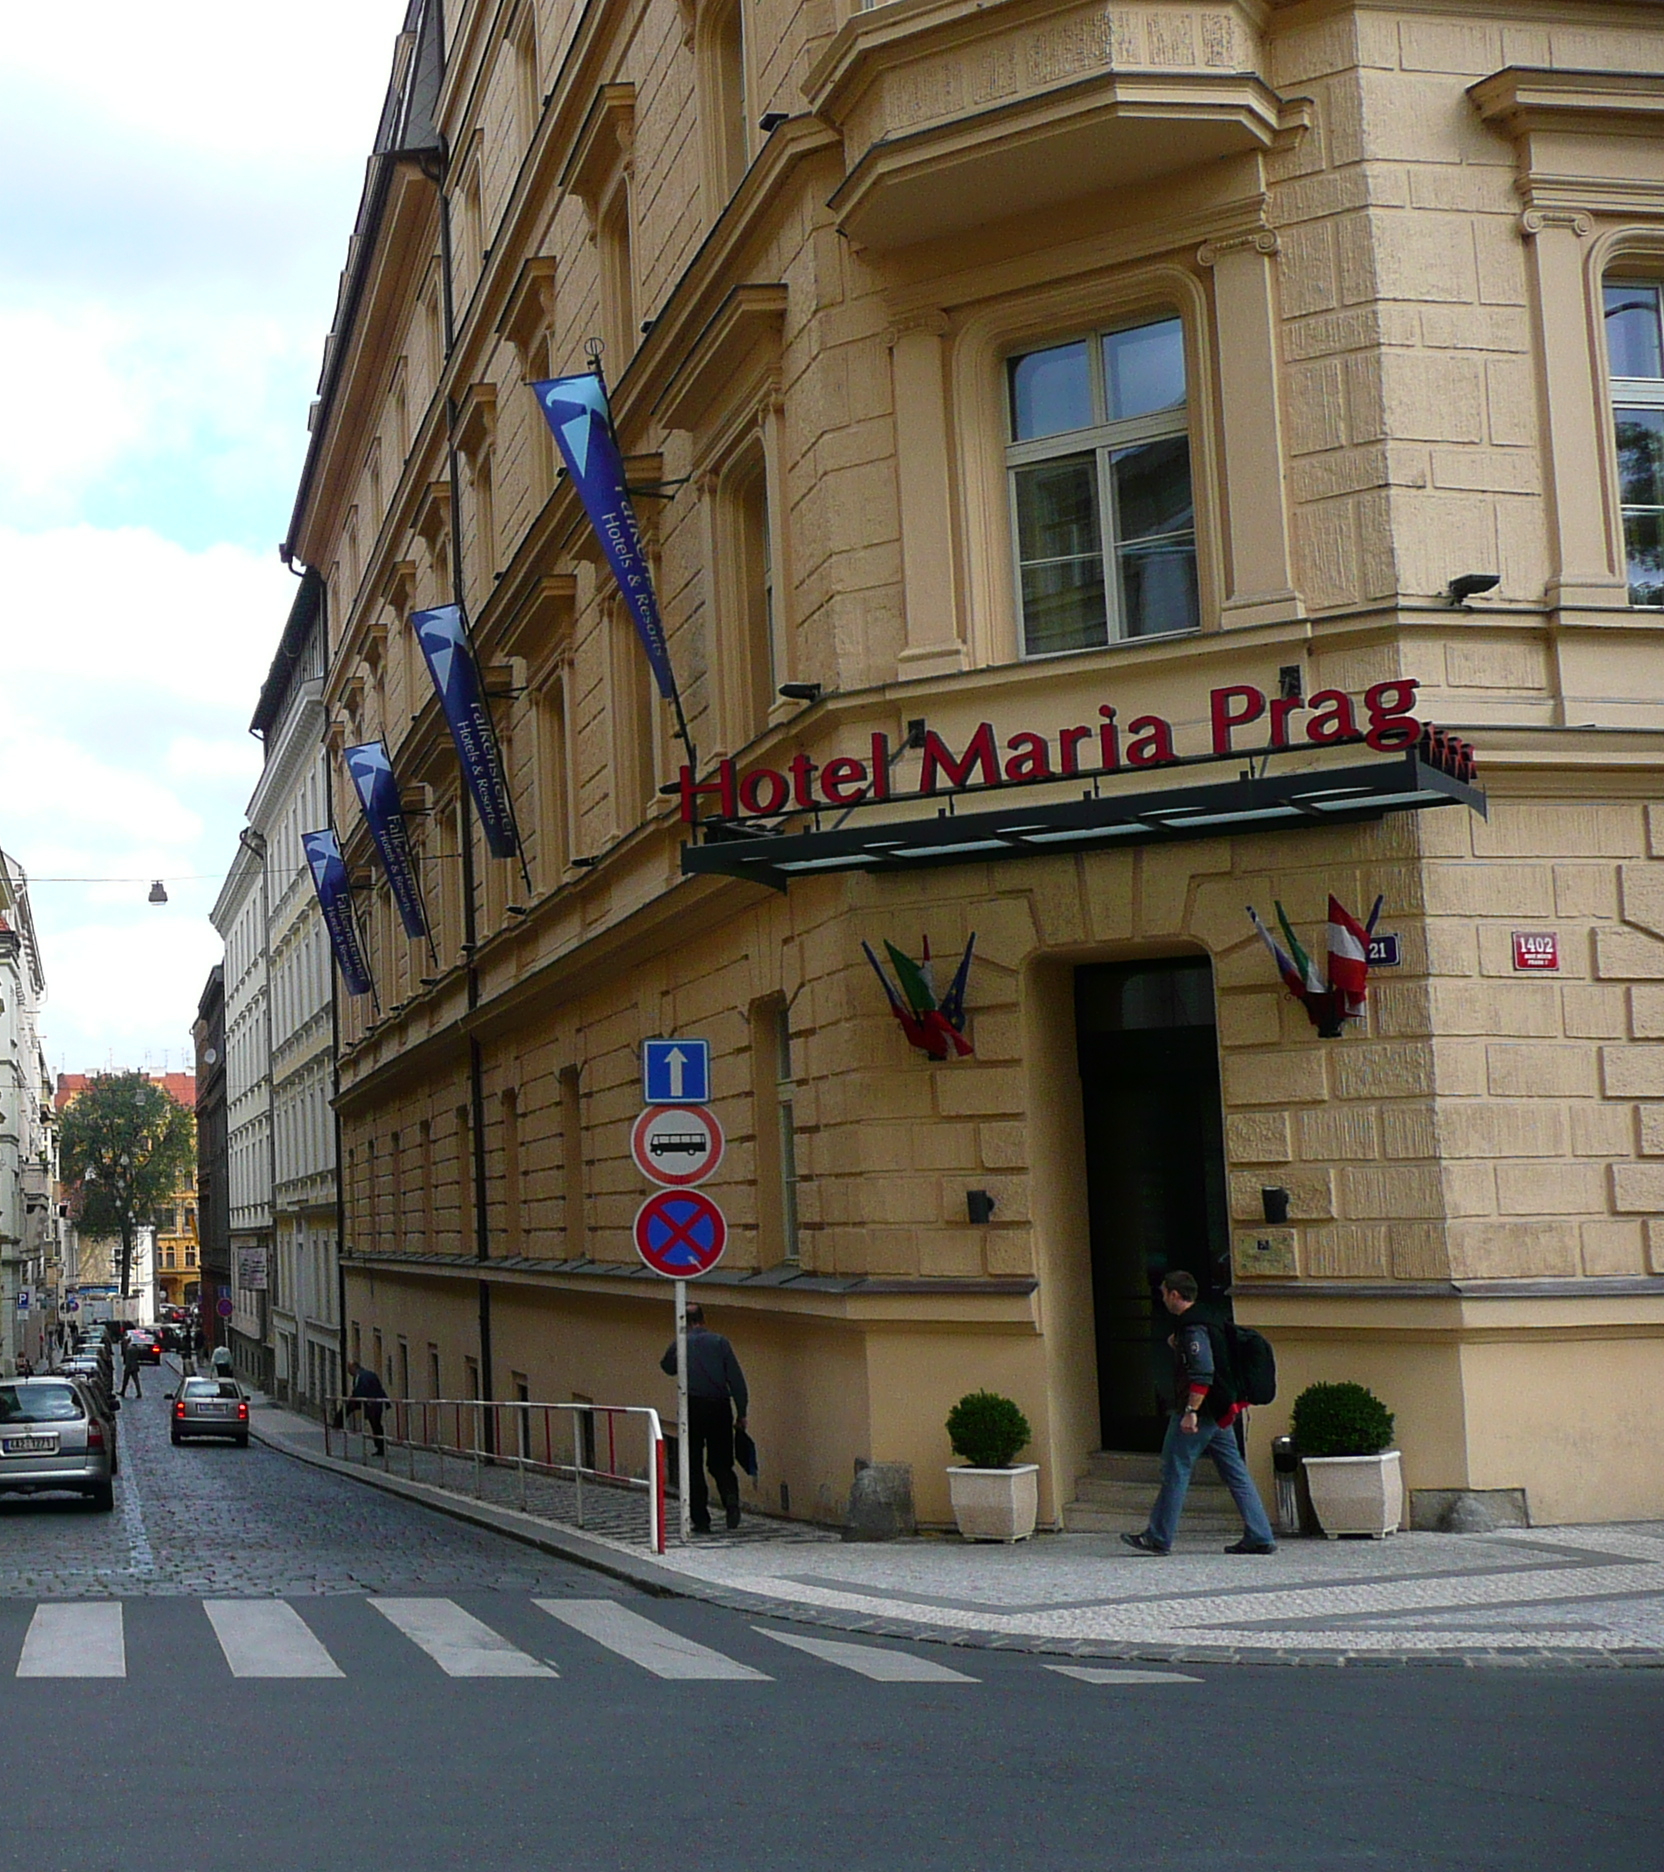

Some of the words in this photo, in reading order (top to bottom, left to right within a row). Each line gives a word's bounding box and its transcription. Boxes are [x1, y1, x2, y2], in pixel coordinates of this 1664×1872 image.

[601, 512, 634, 569] Hotels
[627, 574, 642, 588] &
[635, 593, 663, 656] Resorts
[457, 721, 481, 763] Hotels
[476, 778, 496, 825] Resorts
[679, 731, 890, 823] Hotel
[920, 704, 1177, 794] Maria
[1210, 678, 1424, 752] Prag
[1369, 942, 1387, 959] 21
[1519, 937, 1555, 953] 1402
[18, 1293, 27, 1304] P
